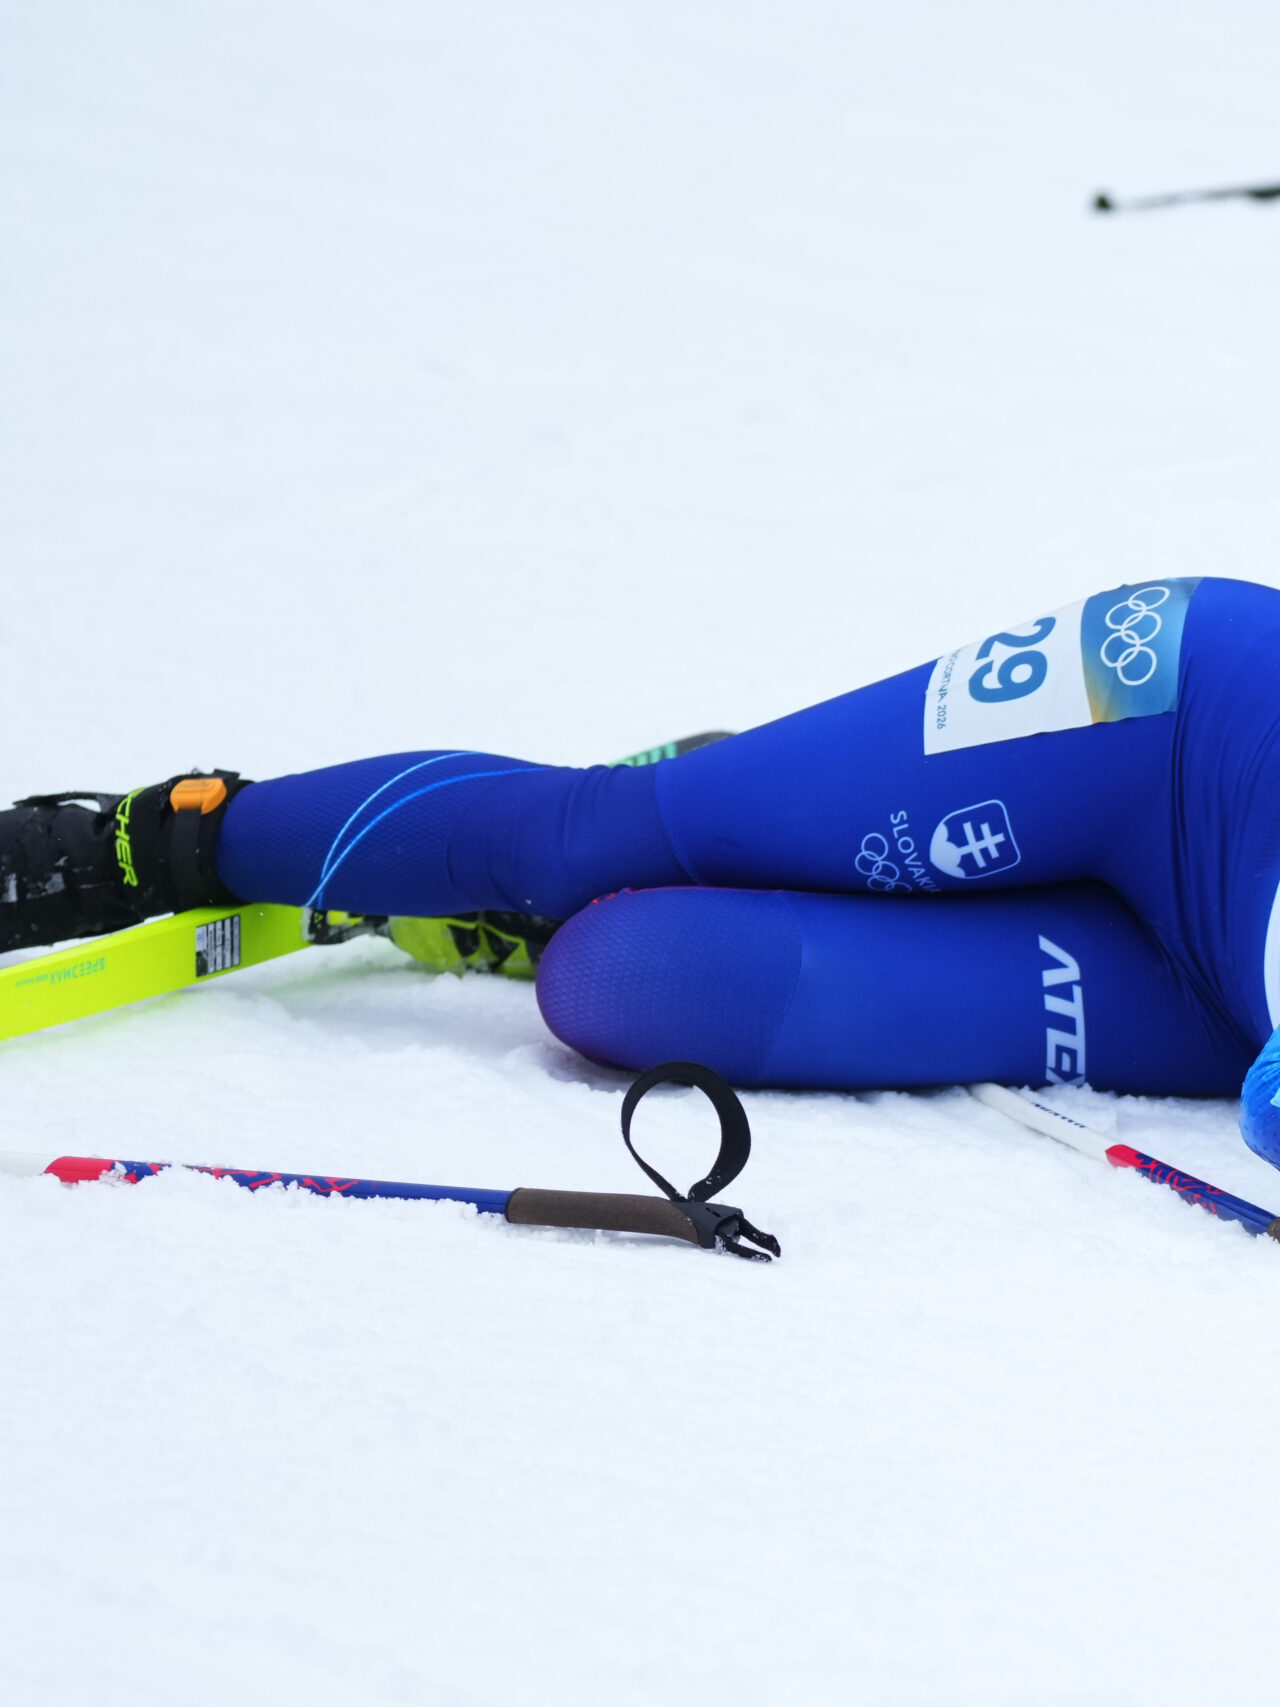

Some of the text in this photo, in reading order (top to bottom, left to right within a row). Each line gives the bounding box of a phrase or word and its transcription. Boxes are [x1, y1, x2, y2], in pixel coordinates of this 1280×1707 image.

[968, 616, 1057, 703] 29
[936, 704, 947, 730] 2026
[115, 787, 147, 887] CHER
[890, 810, 942, 893] SLOVAKI
